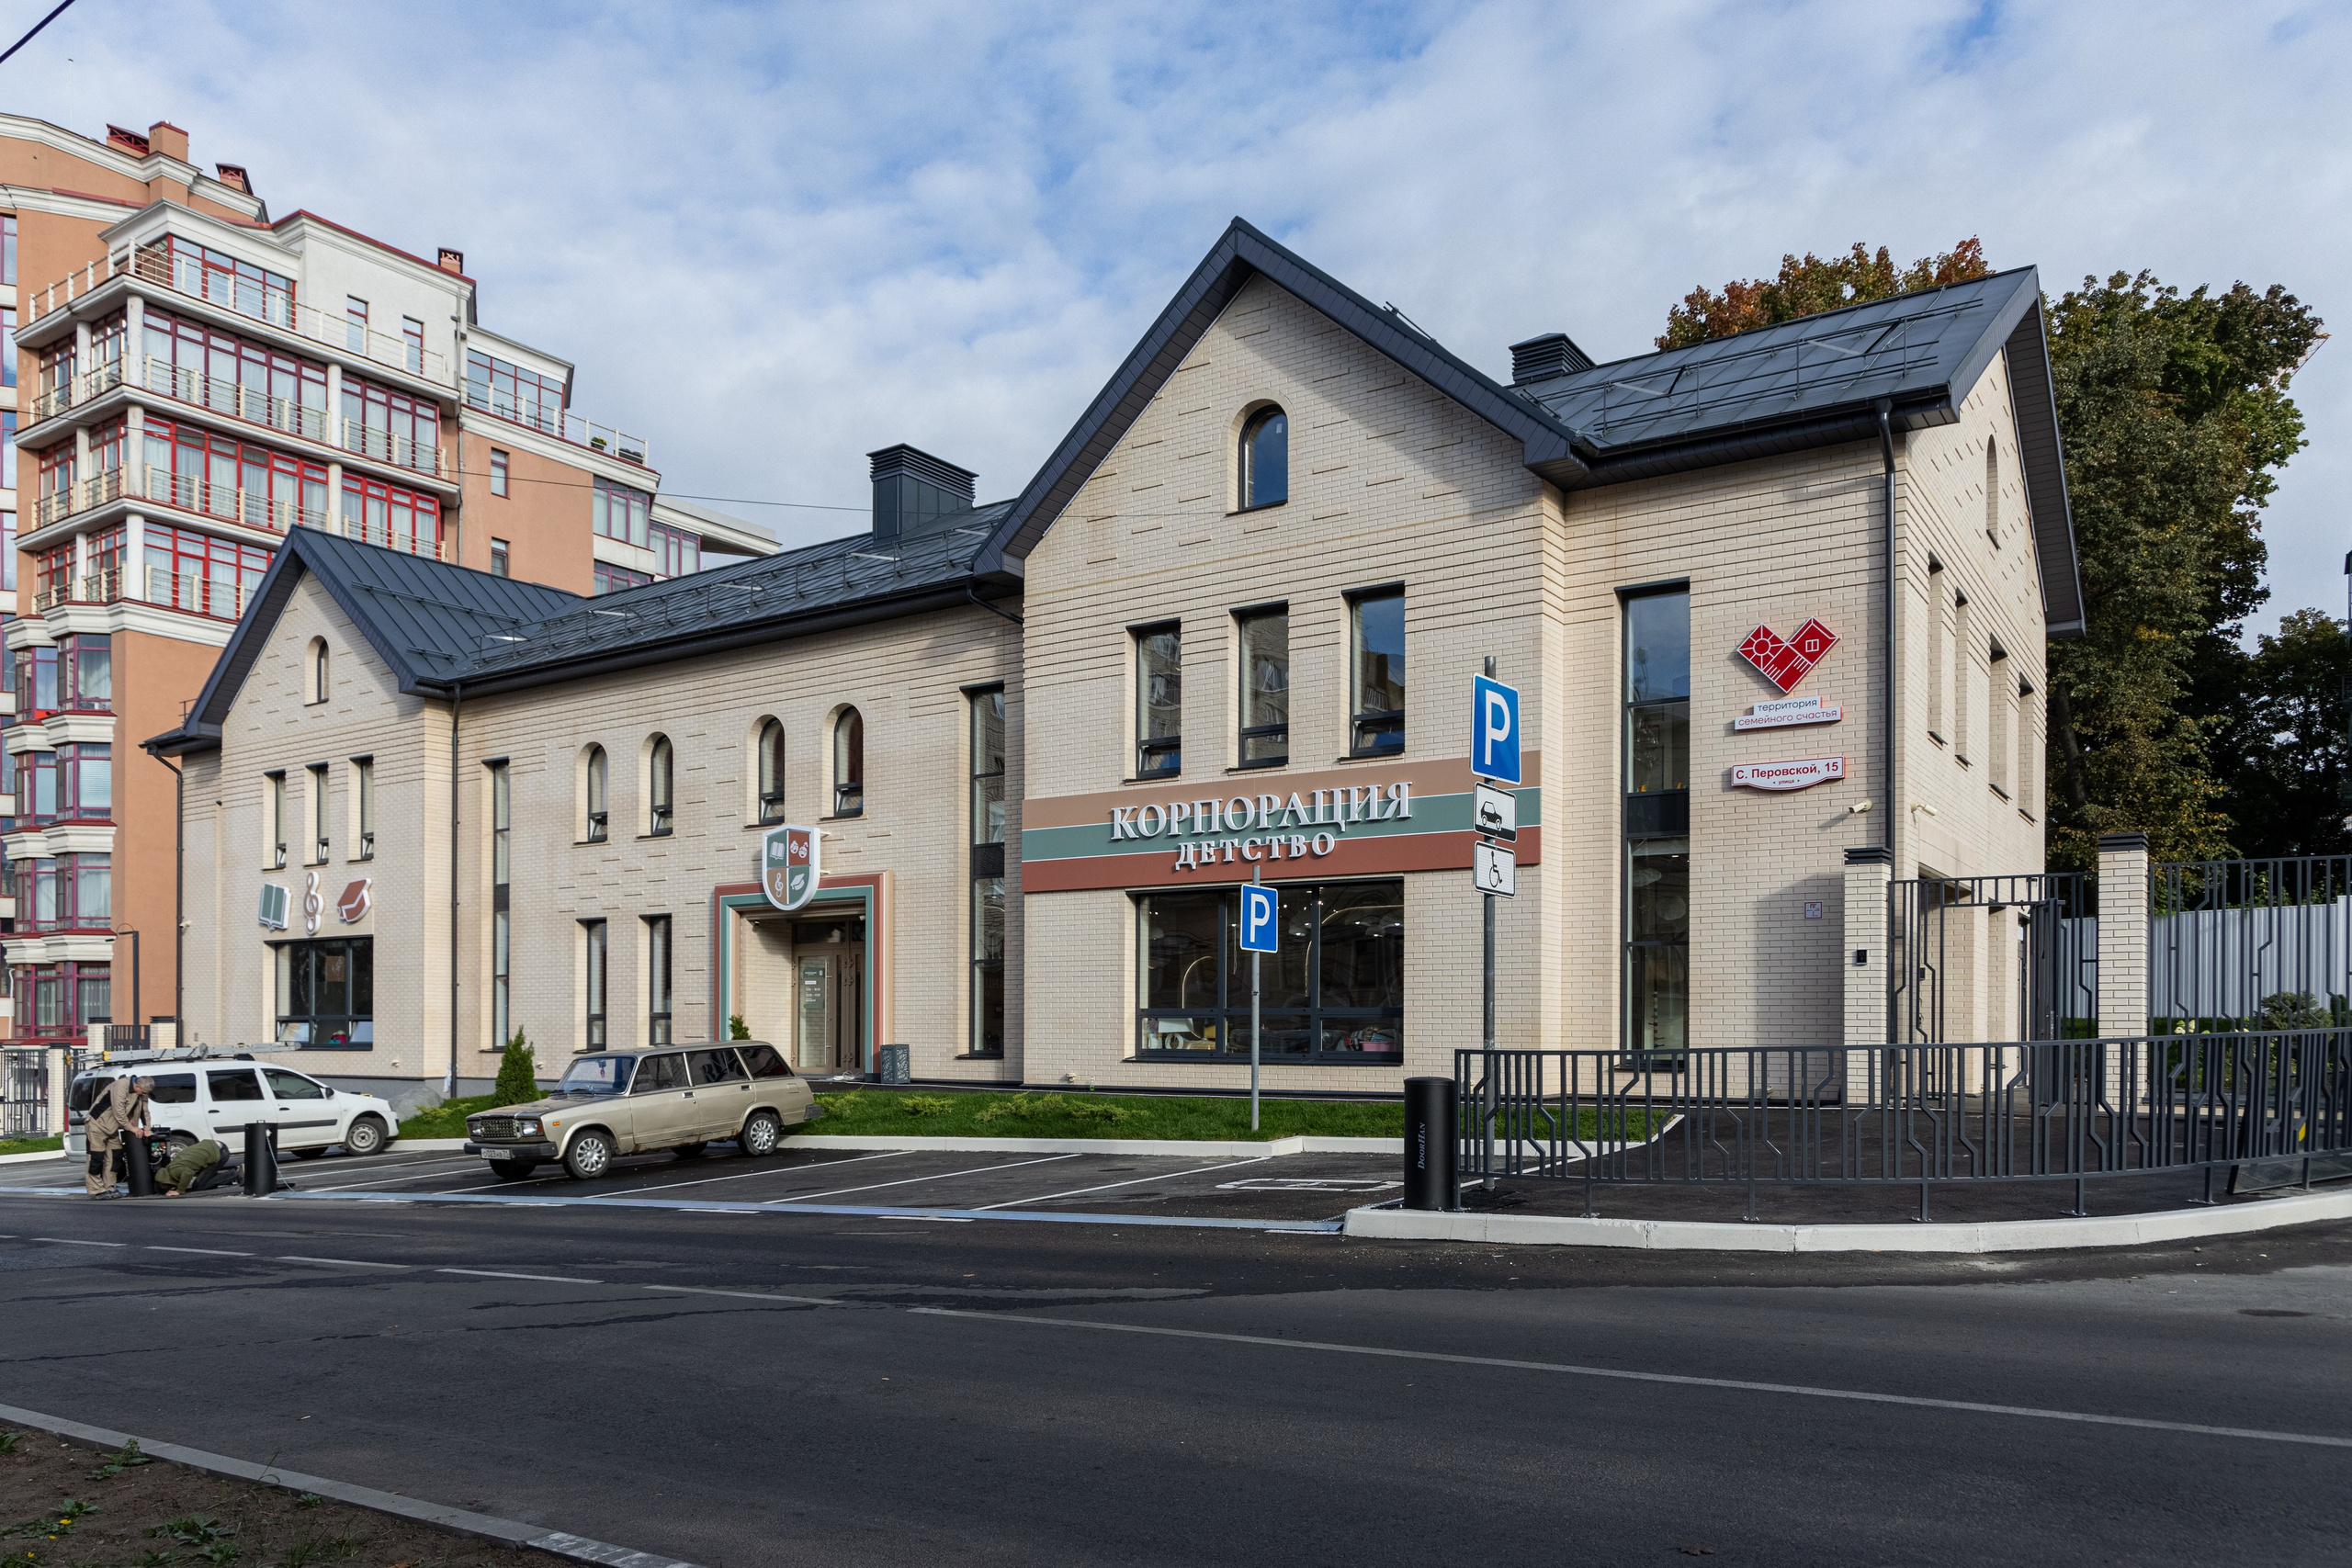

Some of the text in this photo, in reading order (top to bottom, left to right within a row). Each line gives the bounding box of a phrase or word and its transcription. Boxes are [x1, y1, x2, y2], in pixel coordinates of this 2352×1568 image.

[1738, 710, 1838, 726] семейного счастья
[1758, 699, 1817, 713] территория
[1485, 689, 1510, 765] P
[1736, 761, 1838, 779] С. Перовской, 15
[1111, 782, 1413, 840] КОРПОРАЦИЯ
[1175, 832, 1335, 870] ДЕТСТВО
[1250, 894, 1270, 942] P
